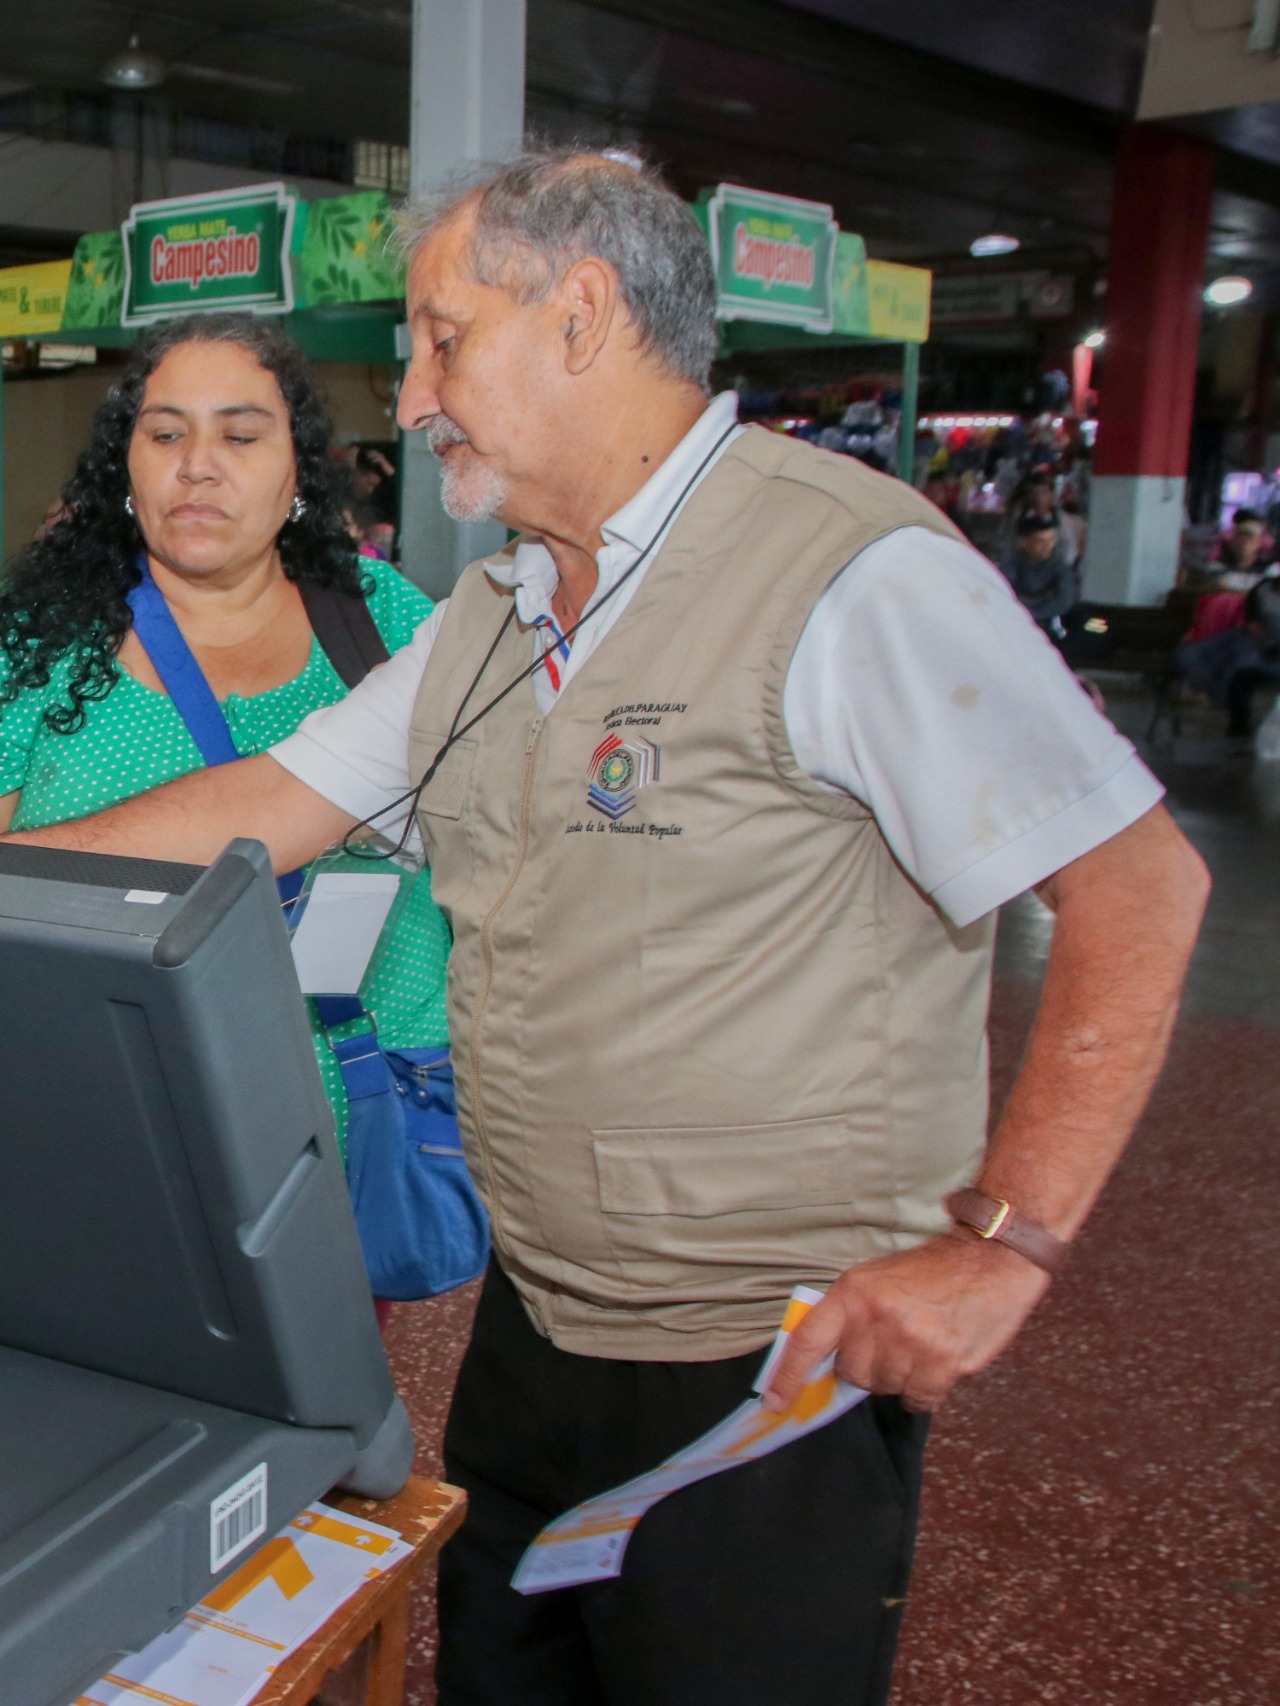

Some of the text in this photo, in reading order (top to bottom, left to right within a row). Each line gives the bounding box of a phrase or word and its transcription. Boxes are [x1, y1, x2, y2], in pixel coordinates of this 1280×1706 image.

[151, 225, 260, 289] Campesino
[734, 222, 815, 290] Campesino
[635, 703, 688, 713] PARAGUAY
[625, 717, 661, 726] Electoral
[585, 821, 595, 833] de
[597, 821, 606, 833] la
[609, 821, 645, 834] Voluntad
[649, 823, 683, 840] Popular
